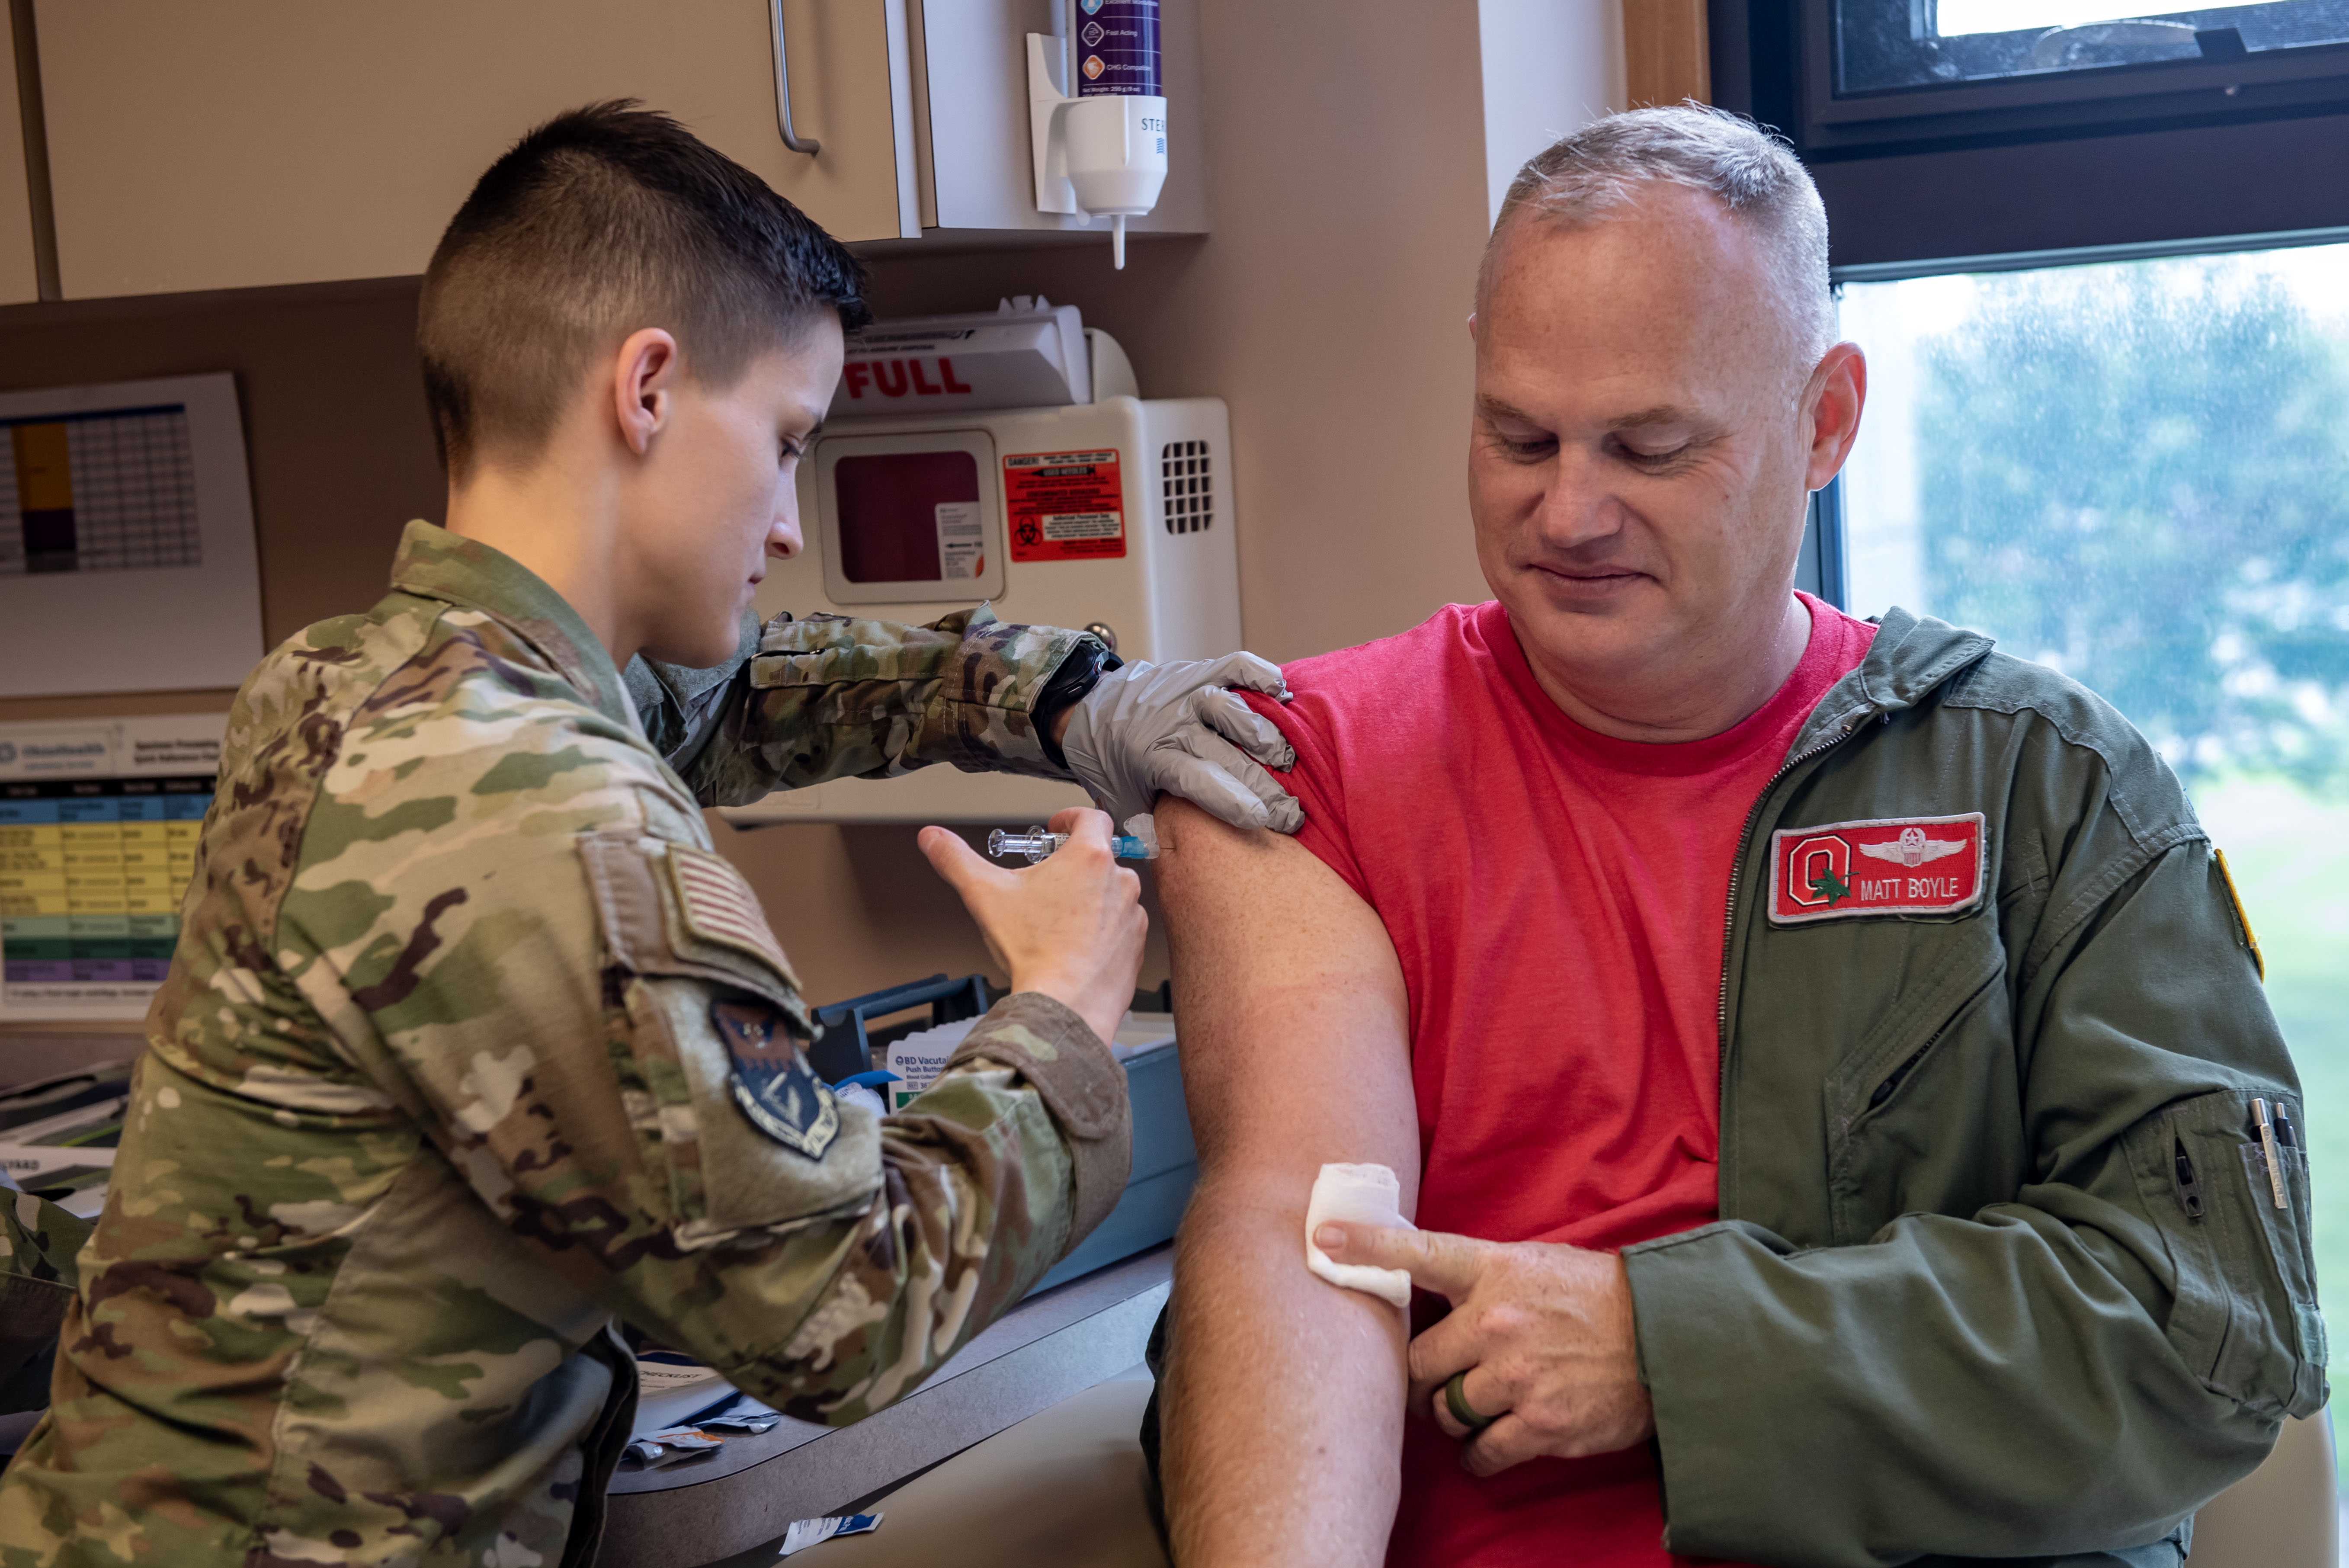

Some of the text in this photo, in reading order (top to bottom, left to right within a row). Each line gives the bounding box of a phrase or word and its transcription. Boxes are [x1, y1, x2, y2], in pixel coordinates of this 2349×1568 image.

[844, 358, 971, 399] FULL
[1861, 877, 1958, 901] MATT BOYLE
[904, 1056, 917, 1065] BD
